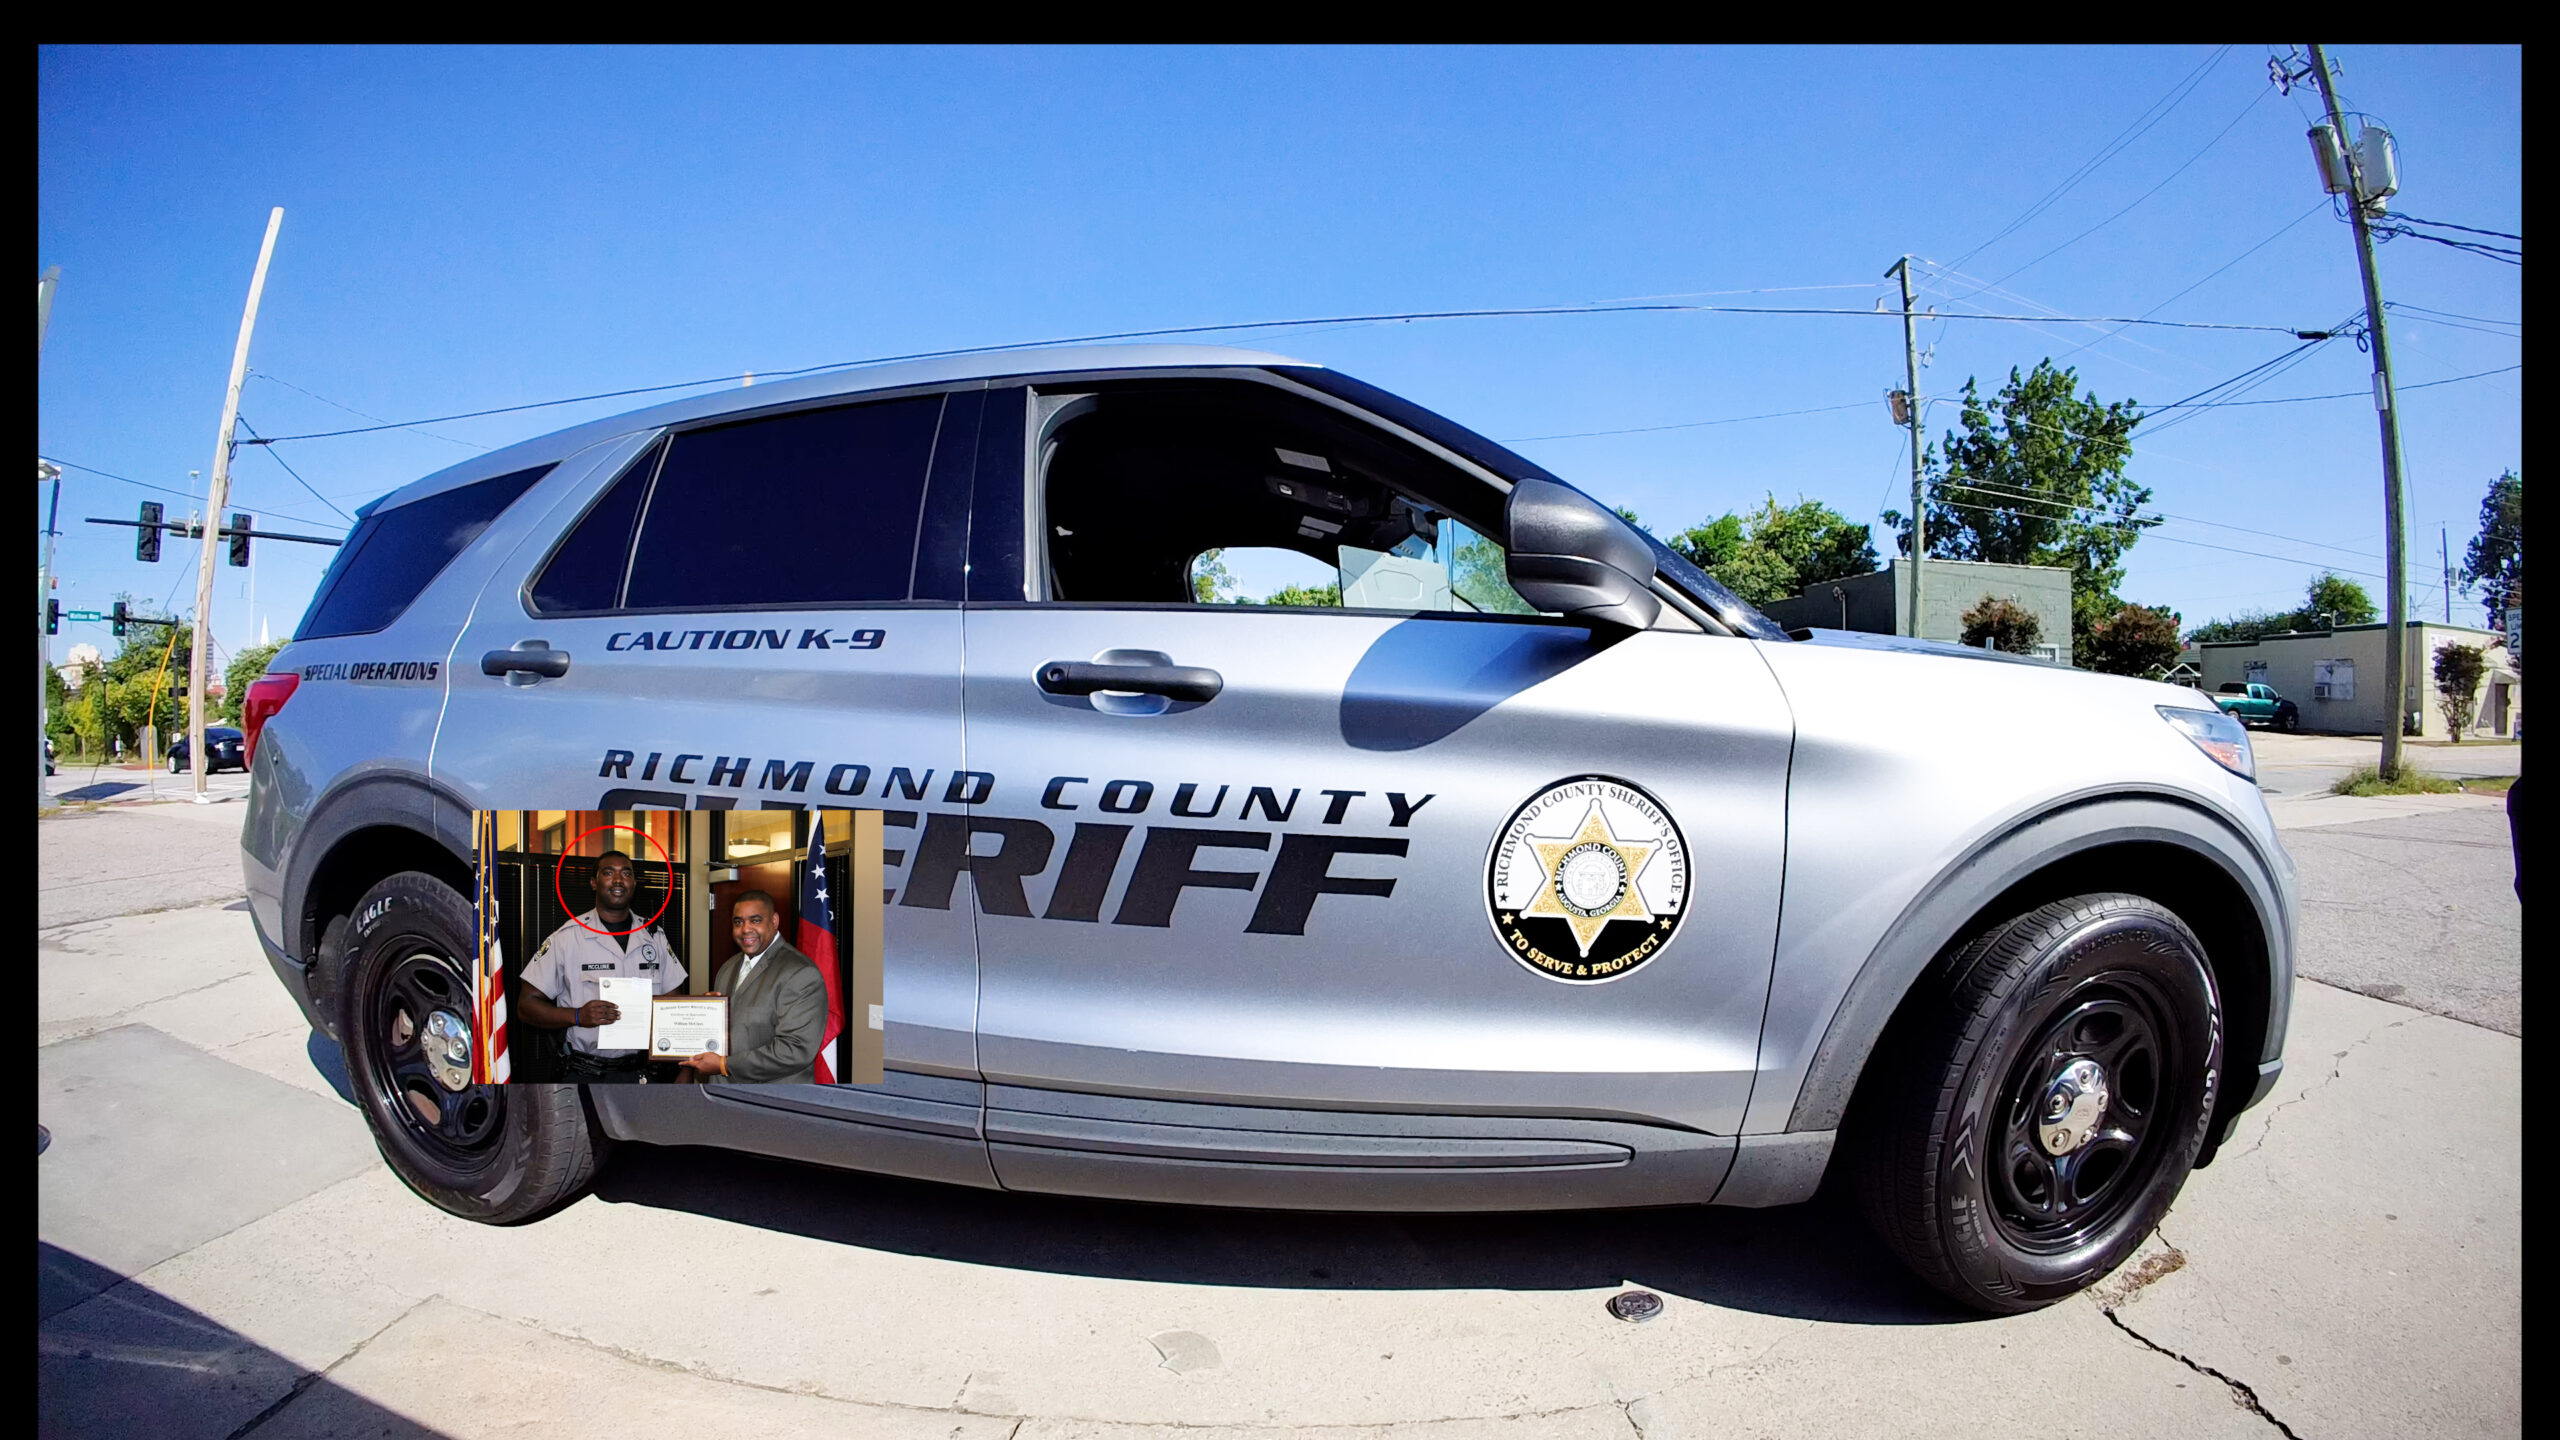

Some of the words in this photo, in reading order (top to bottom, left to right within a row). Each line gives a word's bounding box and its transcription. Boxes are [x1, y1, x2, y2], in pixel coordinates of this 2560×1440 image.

[2508, 613, 2522, 621] SPE
[605, 629, 791, 651] CAUTION
[797, 629, 886, 649] K-9
[304, 663, 348, 681] SPECIAL
[349, 661, 439, 681] OPERATIONS
[598, 748, 996, 805] RICHMOND
[1040, 776, 1437, 828] COUNTY
[1496, 805, 1541, 887] RICHMOND
[1542, 783, 1606, 809] COUNTY
[1608, 785, 1672, 838] SHERIFF'S
[1665, 839, 1683, 894] OFFICE
[1555, 843, 1601, 881] RICHMOND
[1602, 847, 1628, 884] COUNTY
[356, 896, 393, 934] EAGLE
[1509, 928, 1529, 951] TO
[1526, 947, 1574, 975] SERVE
[1576, 964, 1588, 976] &
[1591, 933, 1660, 975] PROTECT
